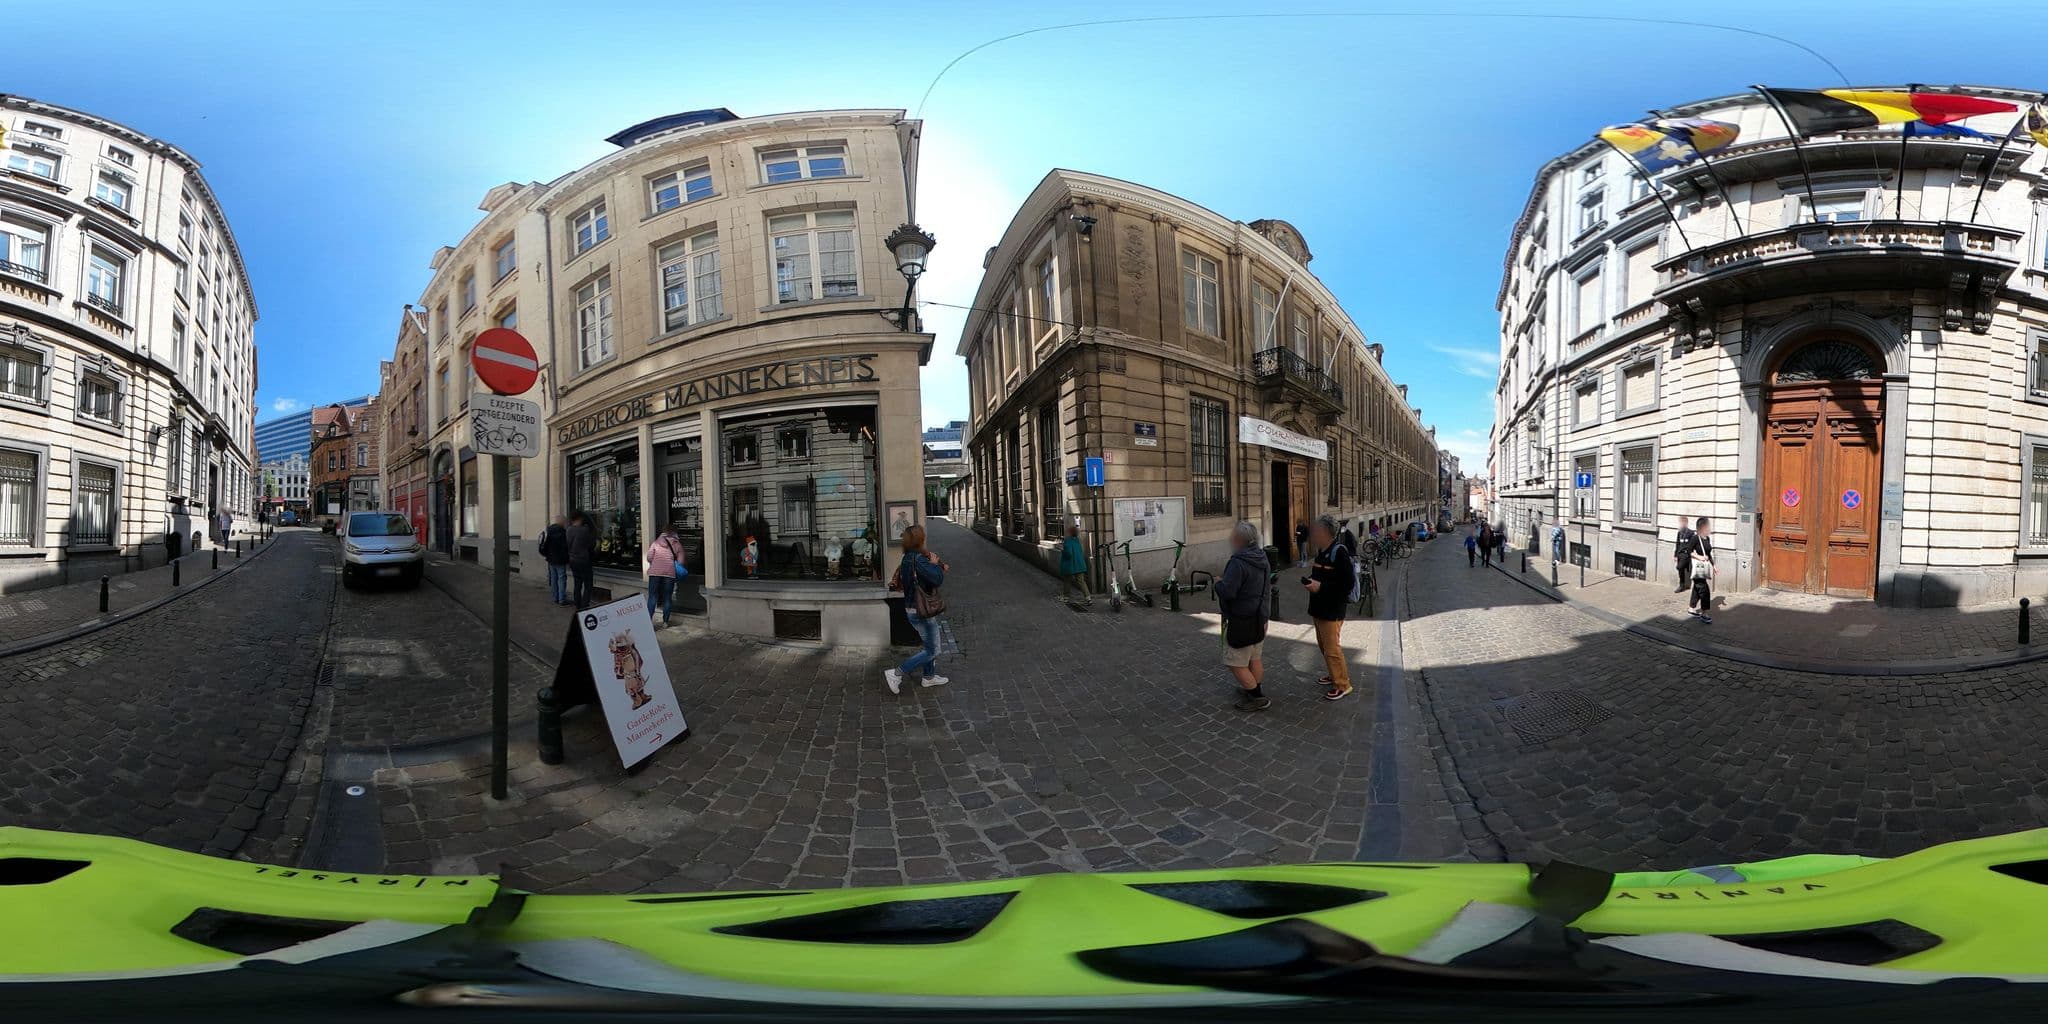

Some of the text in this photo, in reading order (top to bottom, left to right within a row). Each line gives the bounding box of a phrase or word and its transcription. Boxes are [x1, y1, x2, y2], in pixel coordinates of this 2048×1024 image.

[557, 354, 879, 446] GARDEROBE MANNEKENPIS
[616, 602, 644, 617] MUSEUM
